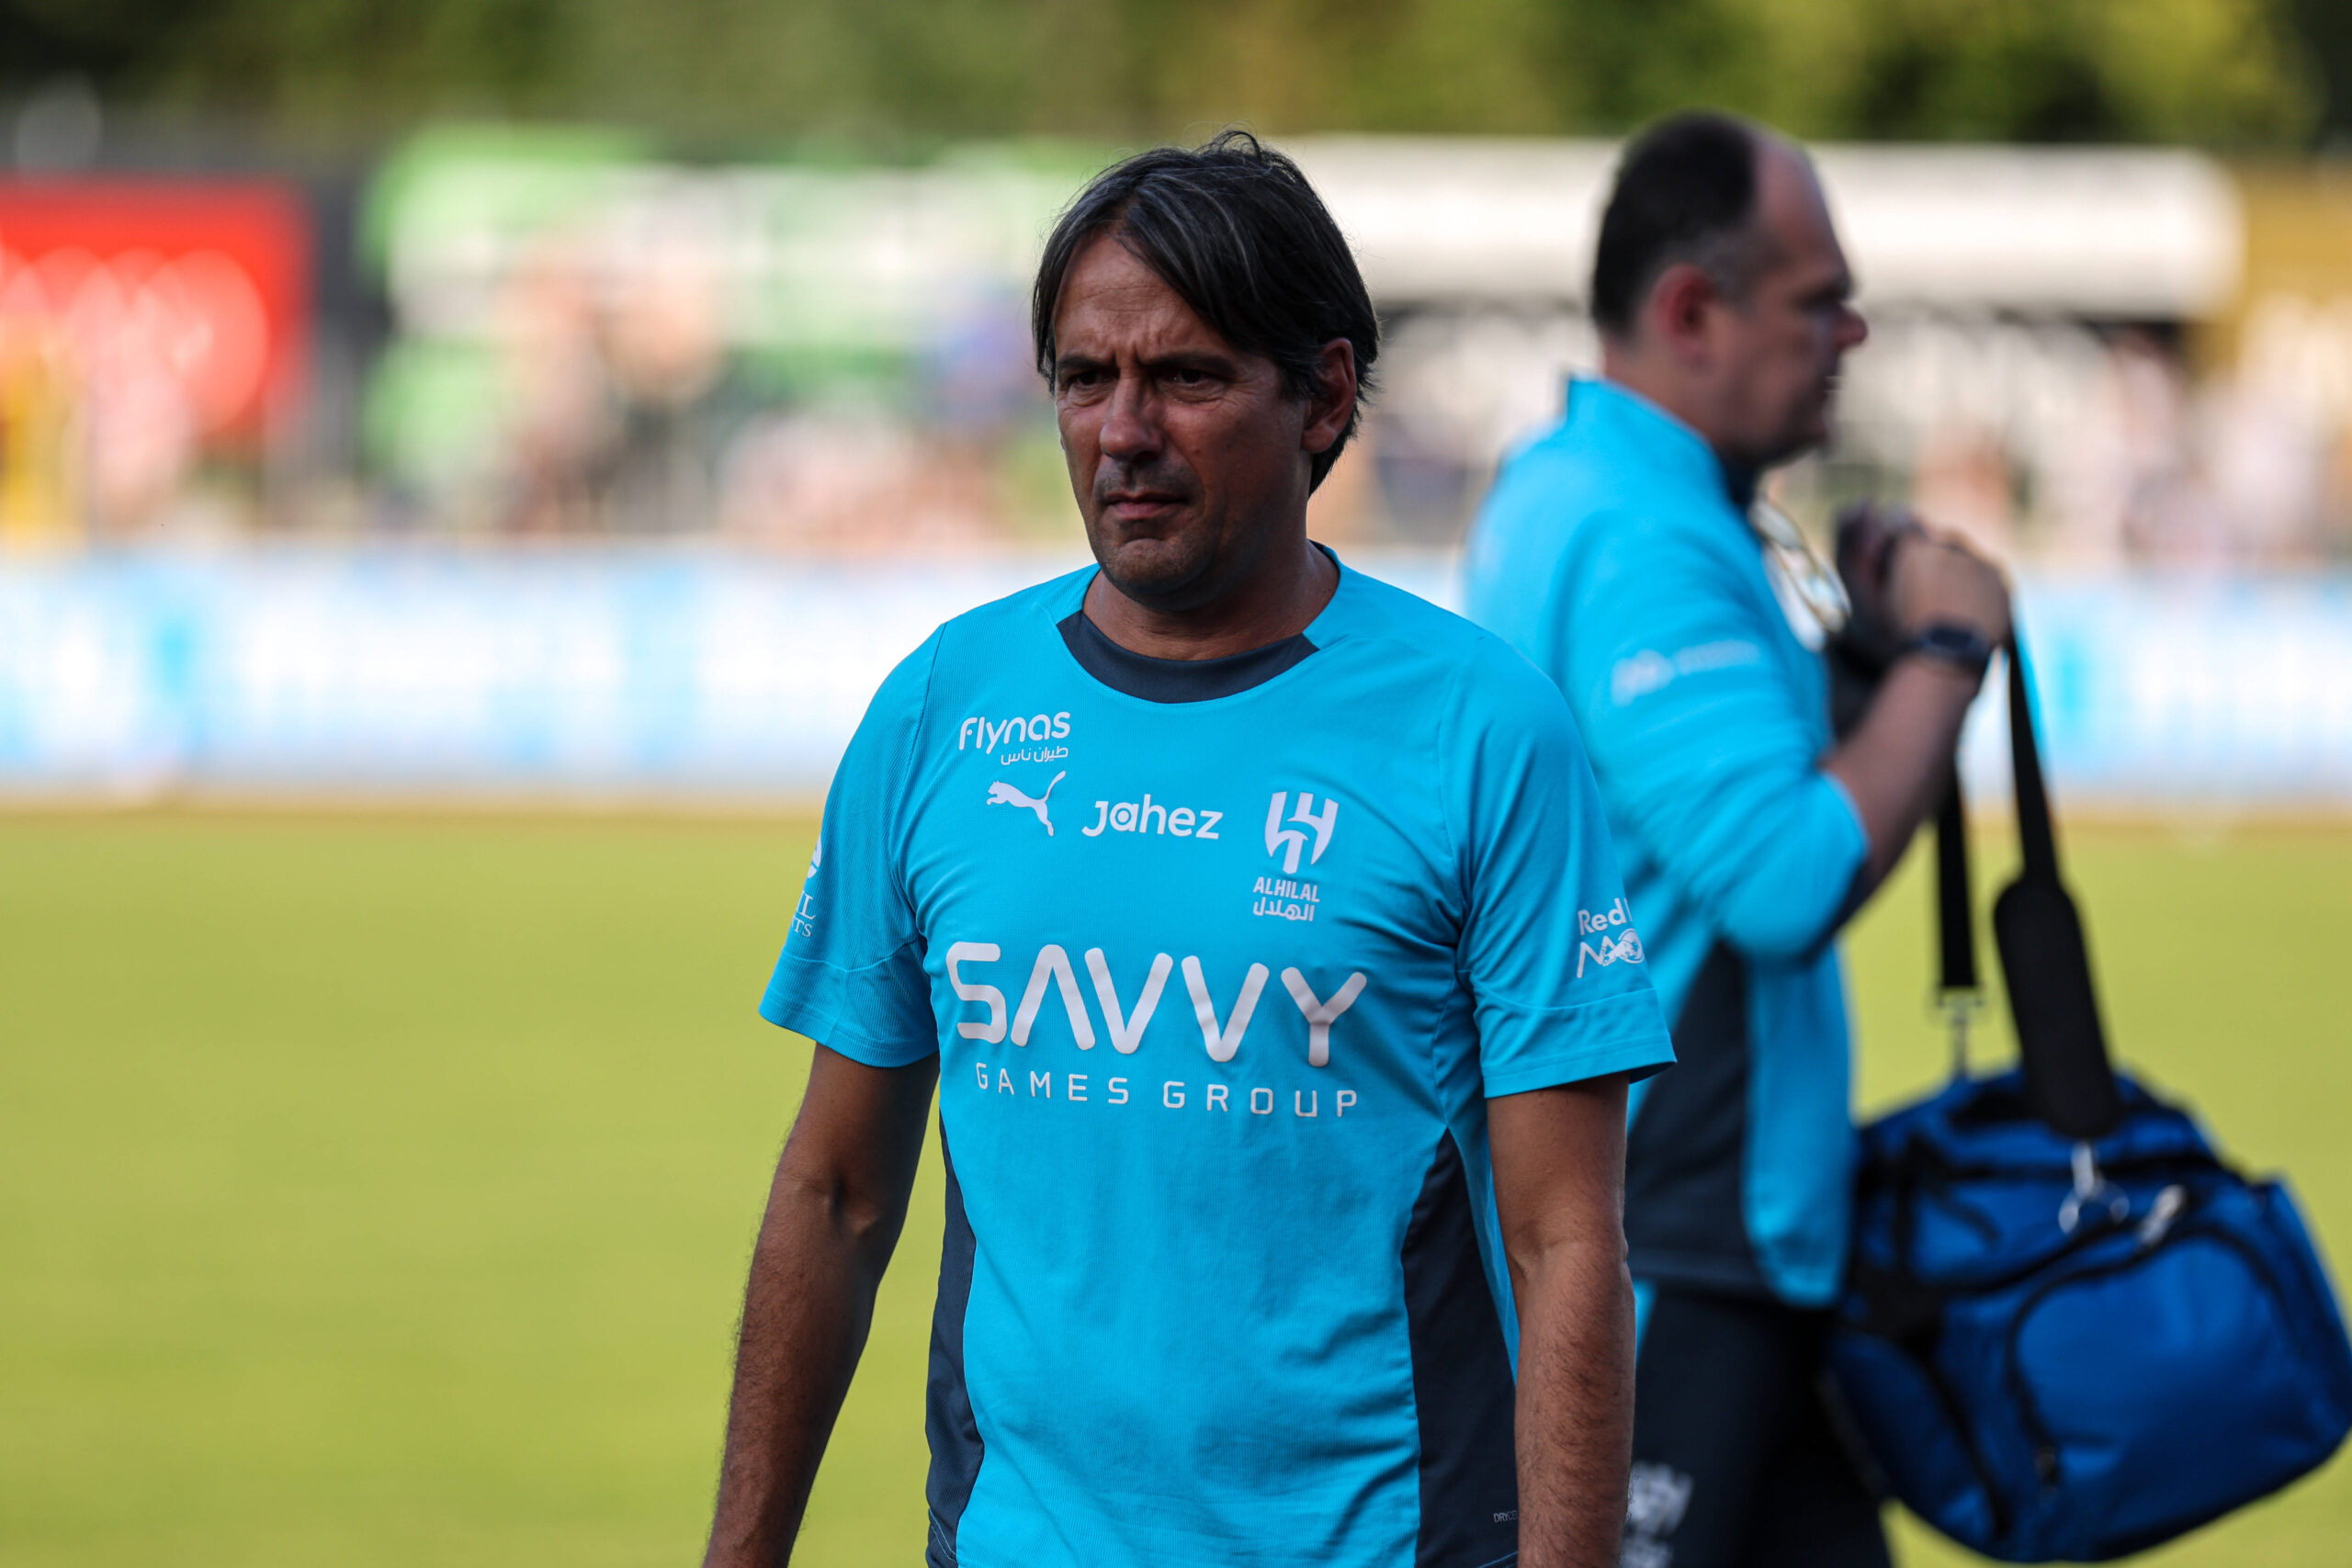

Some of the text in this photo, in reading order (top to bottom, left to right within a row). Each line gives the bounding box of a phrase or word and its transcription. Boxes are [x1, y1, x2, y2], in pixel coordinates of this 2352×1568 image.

[958, 711, 1071, 755] flynas
[1252, 876, 1320, 903] ALHILAL
[1252, 896, 1316, 922] الهلال
[945, 941, 1367, 1067] SAVVY
[976, 1062, 1357, 1118] GAMES GROUP
